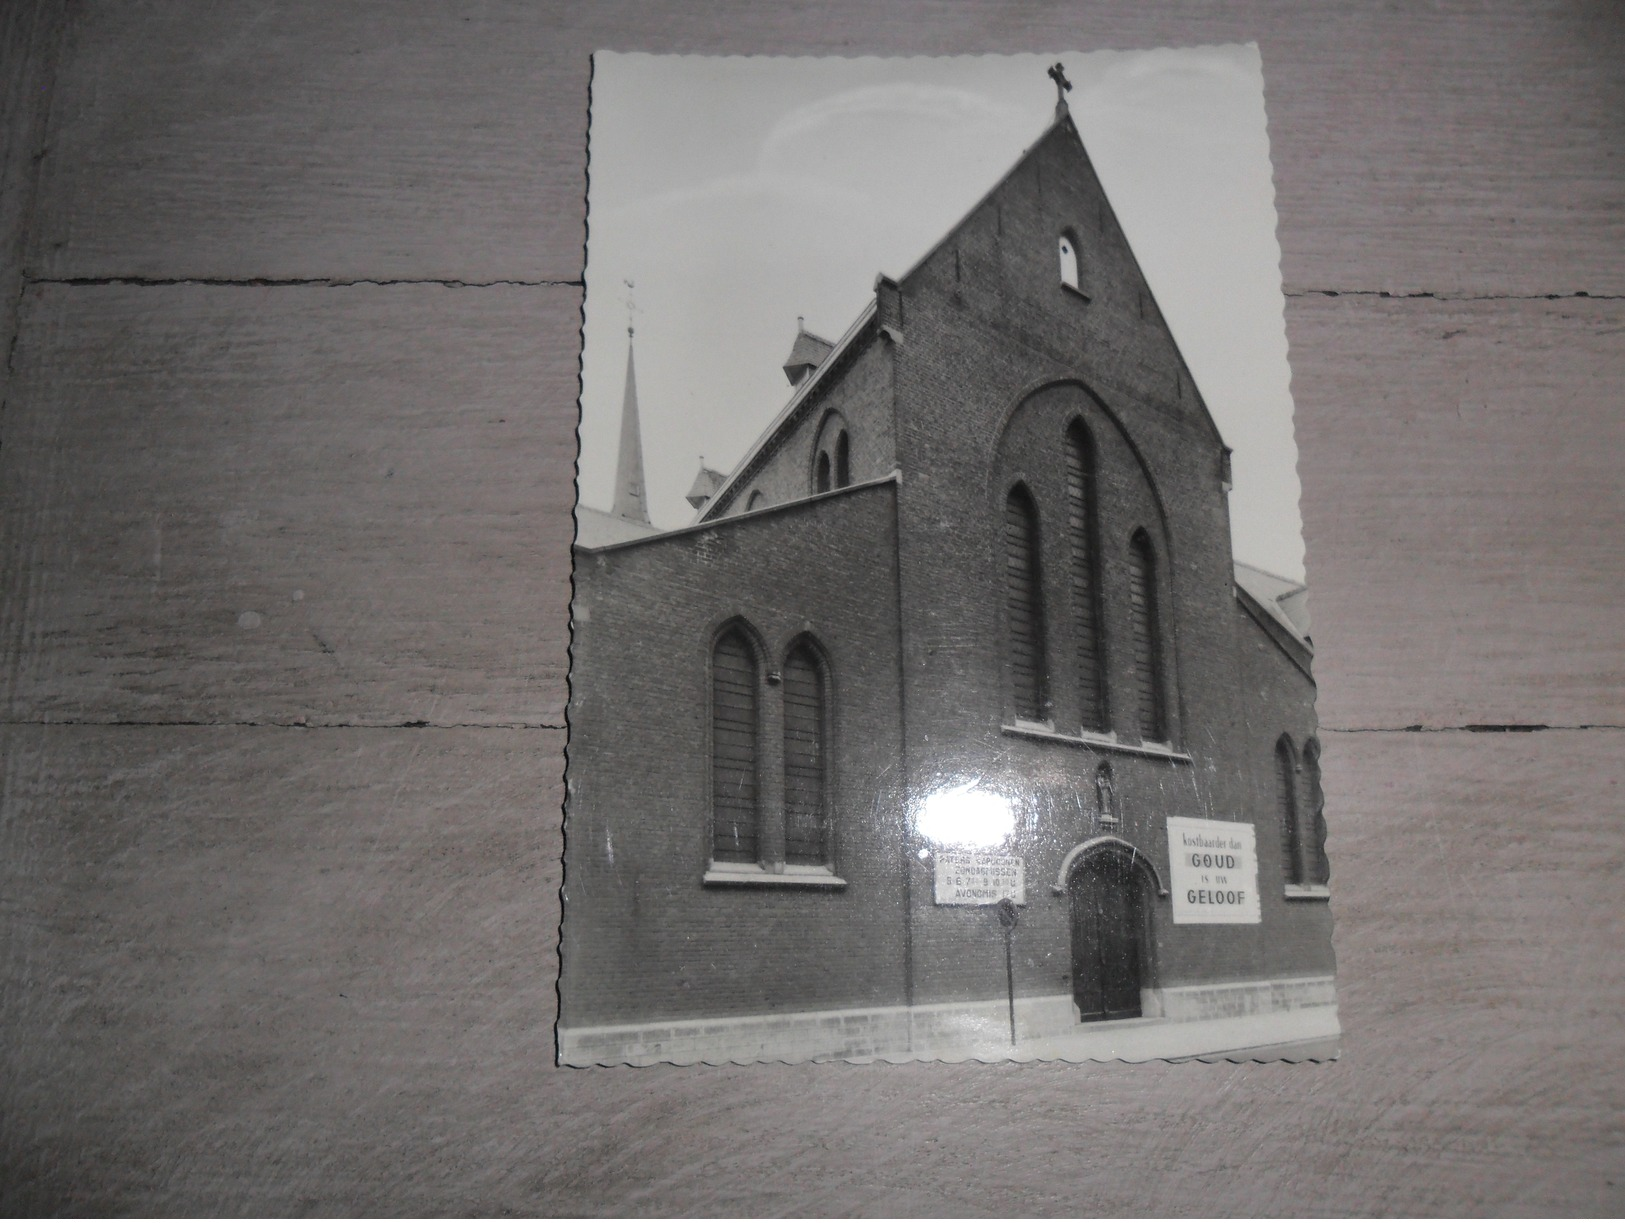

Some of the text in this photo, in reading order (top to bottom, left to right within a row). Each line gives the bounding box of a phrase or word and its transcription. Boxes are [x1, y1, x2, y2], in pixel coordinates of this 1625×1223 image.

[1182, 832, 1242, 850] kostbaarder dan
[1191, 853, 1235, 869] GOUD
[1187, 889, 1246, 905] GELOOF
